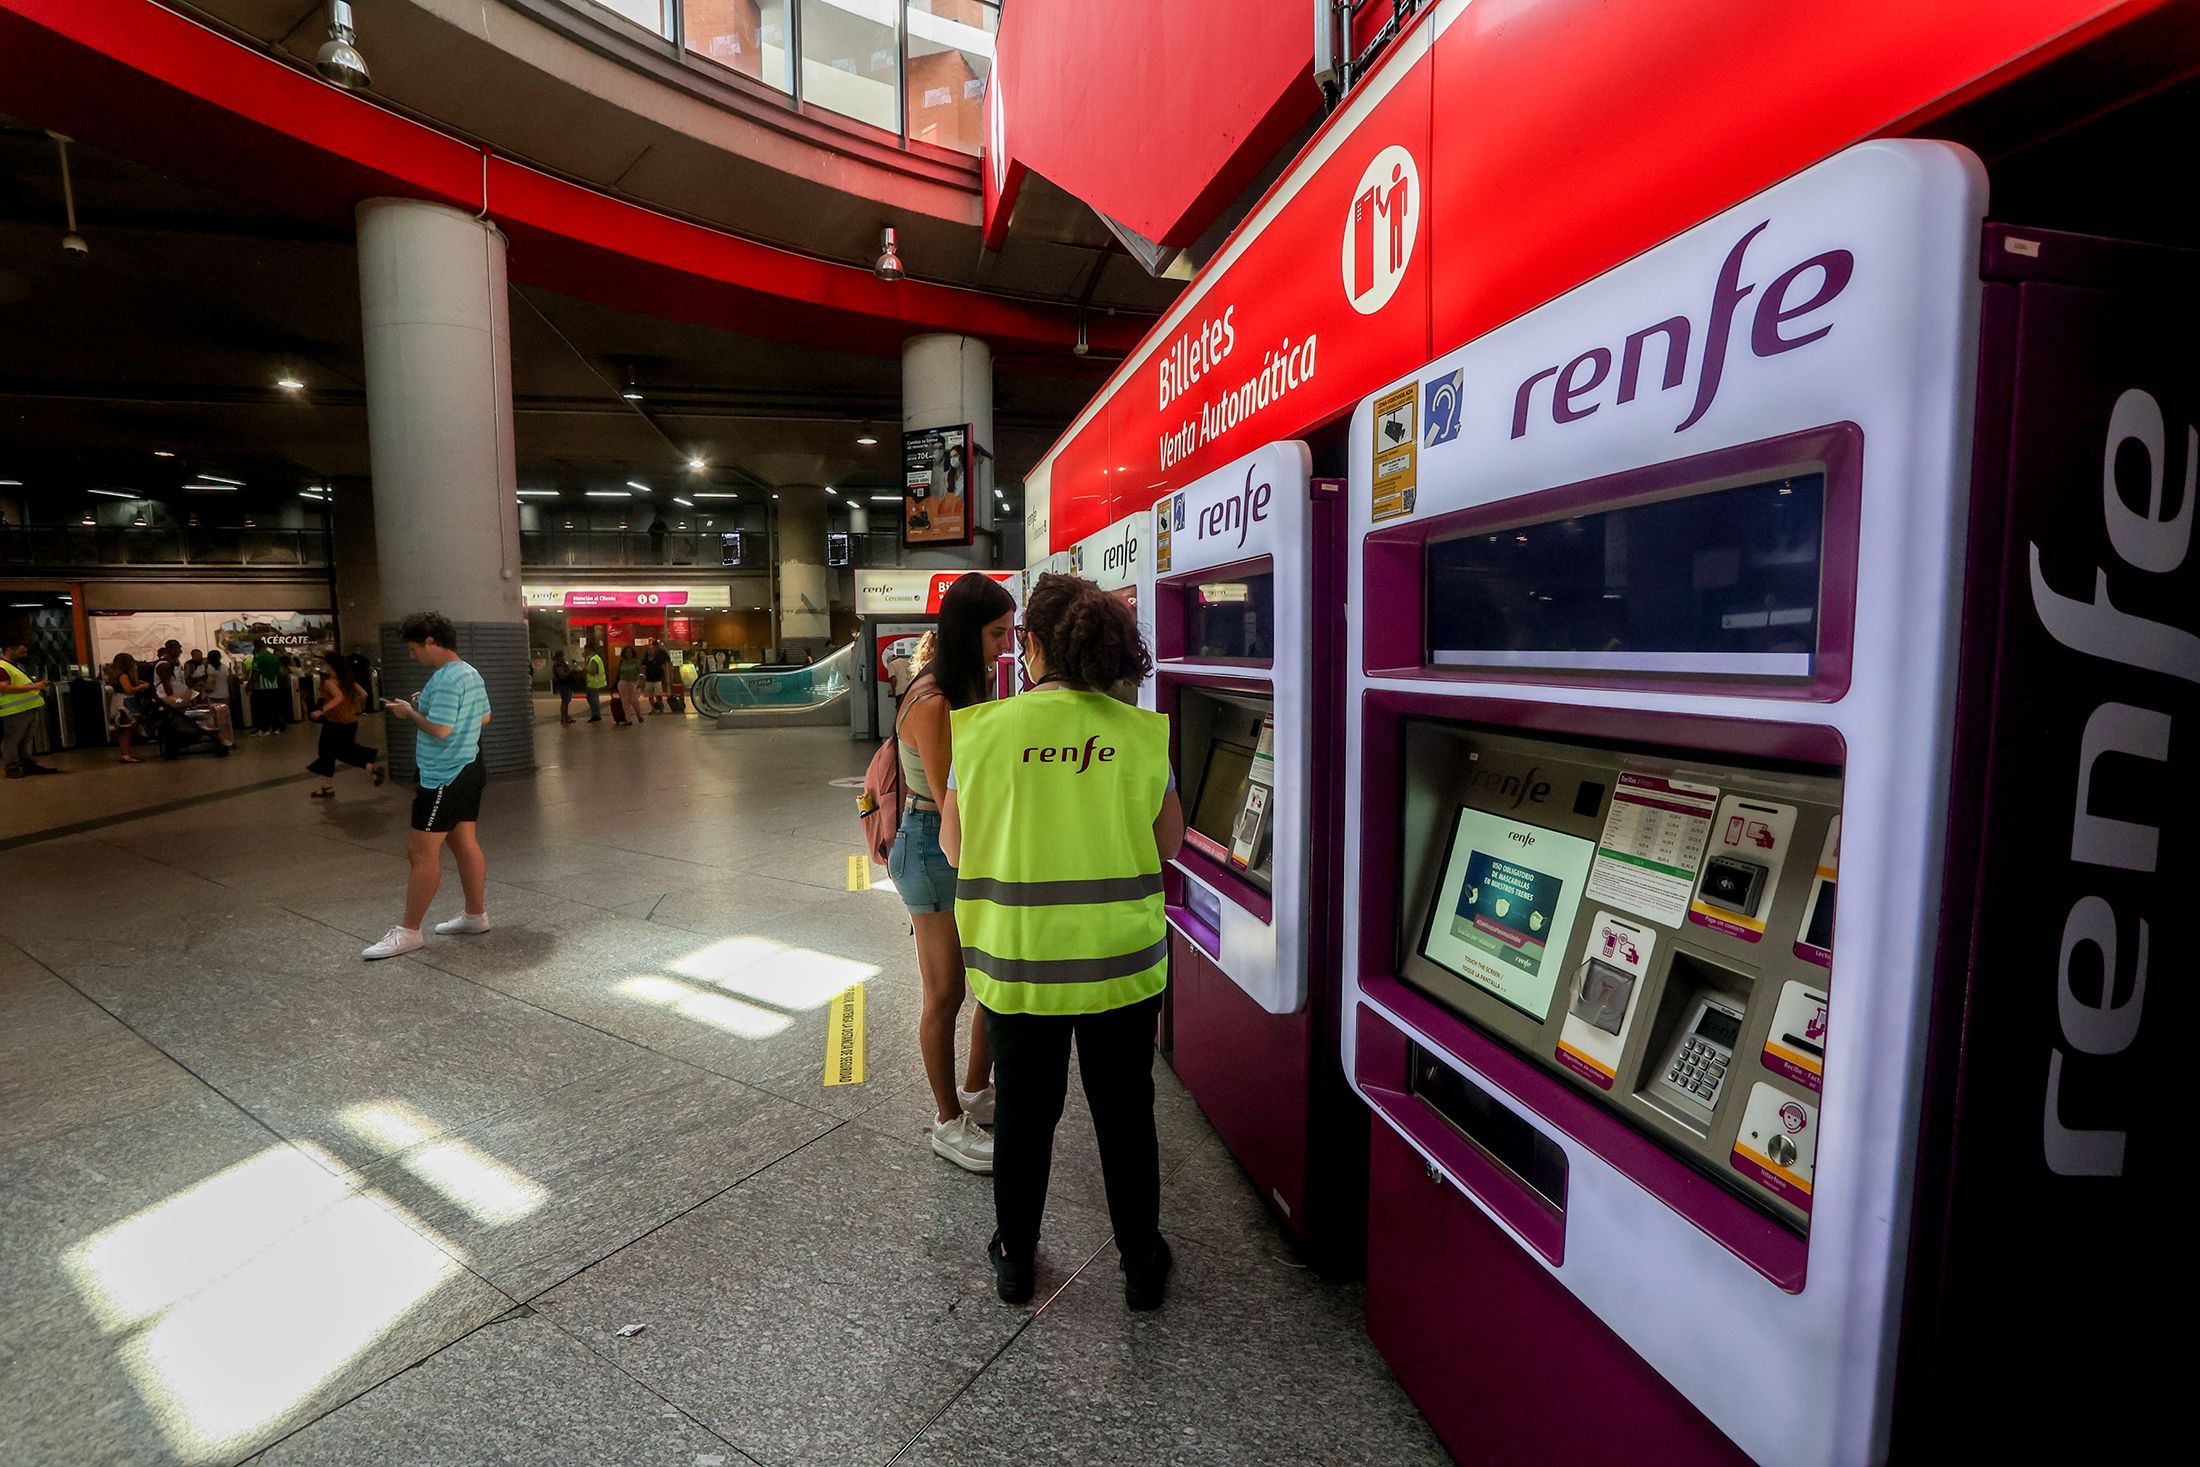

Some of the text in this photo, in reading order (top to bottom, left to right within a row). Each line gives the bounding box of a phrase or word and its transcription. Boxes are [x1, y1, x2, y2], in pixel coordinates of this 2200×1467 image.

[1510, 218, 1854, 440] renfe
[1160, 304, 1234, 412] Billetes
[1160, 334, 1317, 472] Venta Automática
[1199, 463, 1271, 549] renfe
[1103, 524, 1137, 579] renfe
[532, 592, 558, 600] renfe
[863, 584, 893, 595] renfe
[1022, 735, 1116, 774] renfe
[2030, 388, 2200, 1177] renfe
[1508, 831, 1536, 847] renfe
[1492, 862, 1534, 881] USO OBLIGATORIO
[1499, 873, 1530, 890] MASCARILLAS
[1484, 877, 1534, 901] EN NUESTROS TRENES
[1515, 954, 1531, 968] renfe
[1783, 1062, 1803, 1074] Recibo
